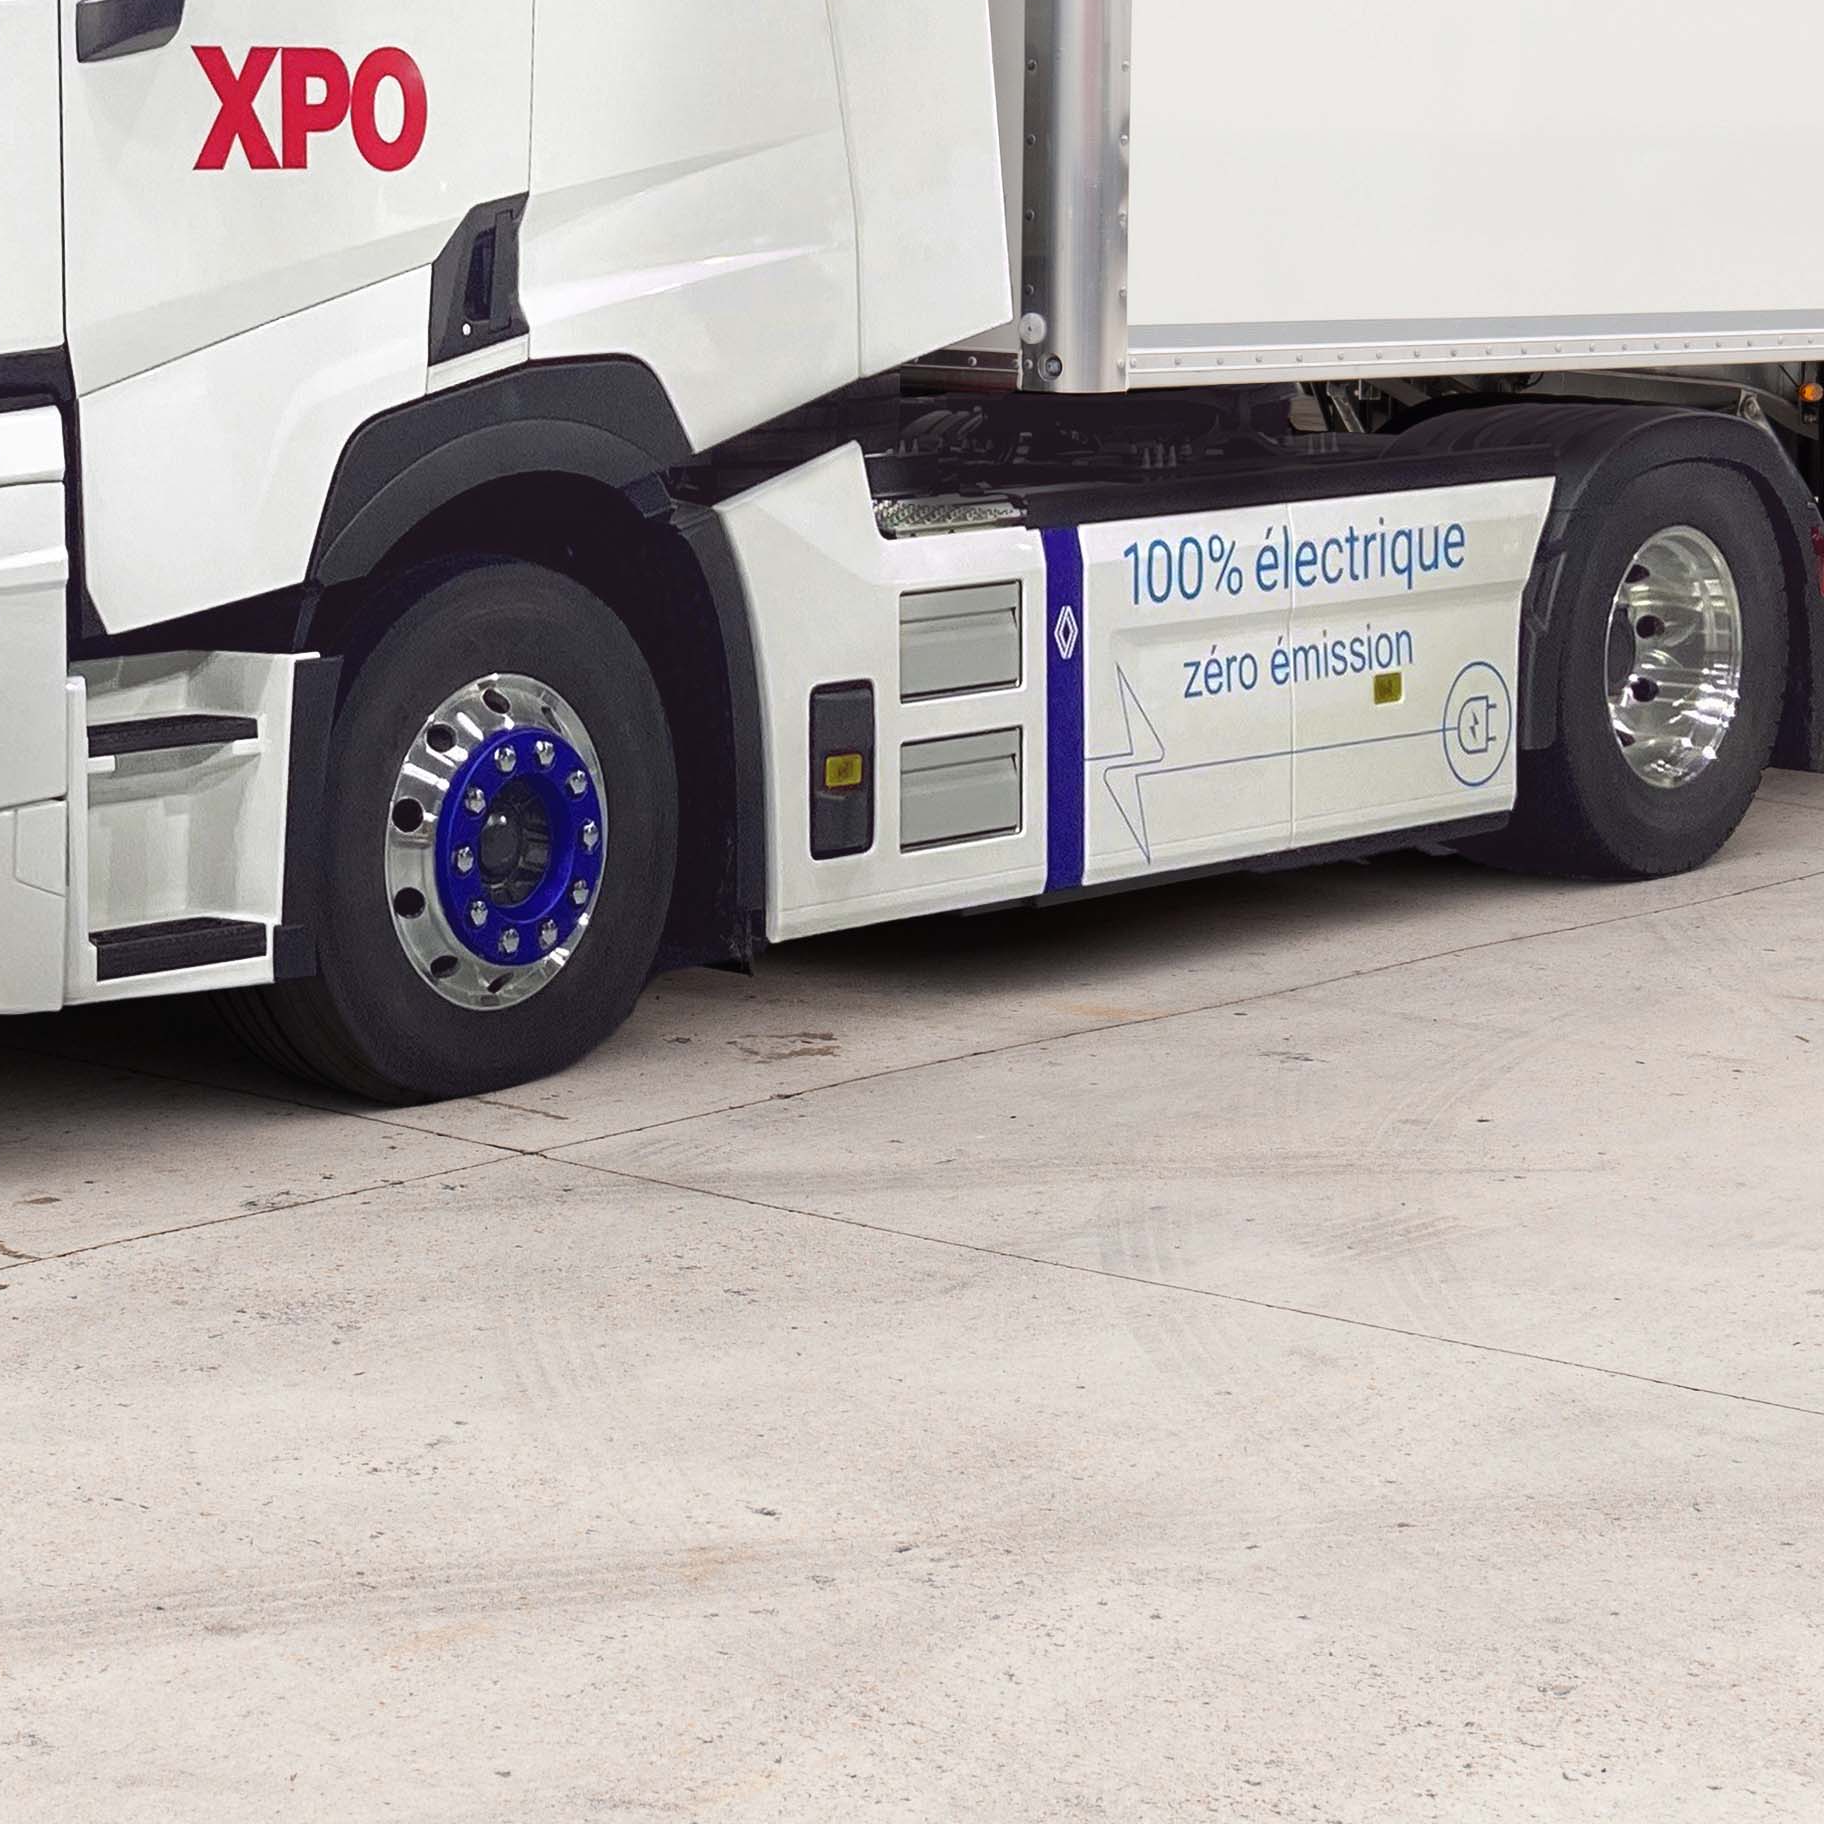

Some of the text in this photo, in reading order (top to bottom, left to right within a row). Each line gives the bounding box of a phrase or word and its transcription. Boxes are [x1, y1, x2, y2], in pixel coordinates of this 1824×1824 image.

[190, 44, 428, 173] XPO
[1122, 516, 1467, 606] 100% électrique
[1182, 623, 1415, 699] zéro émission
